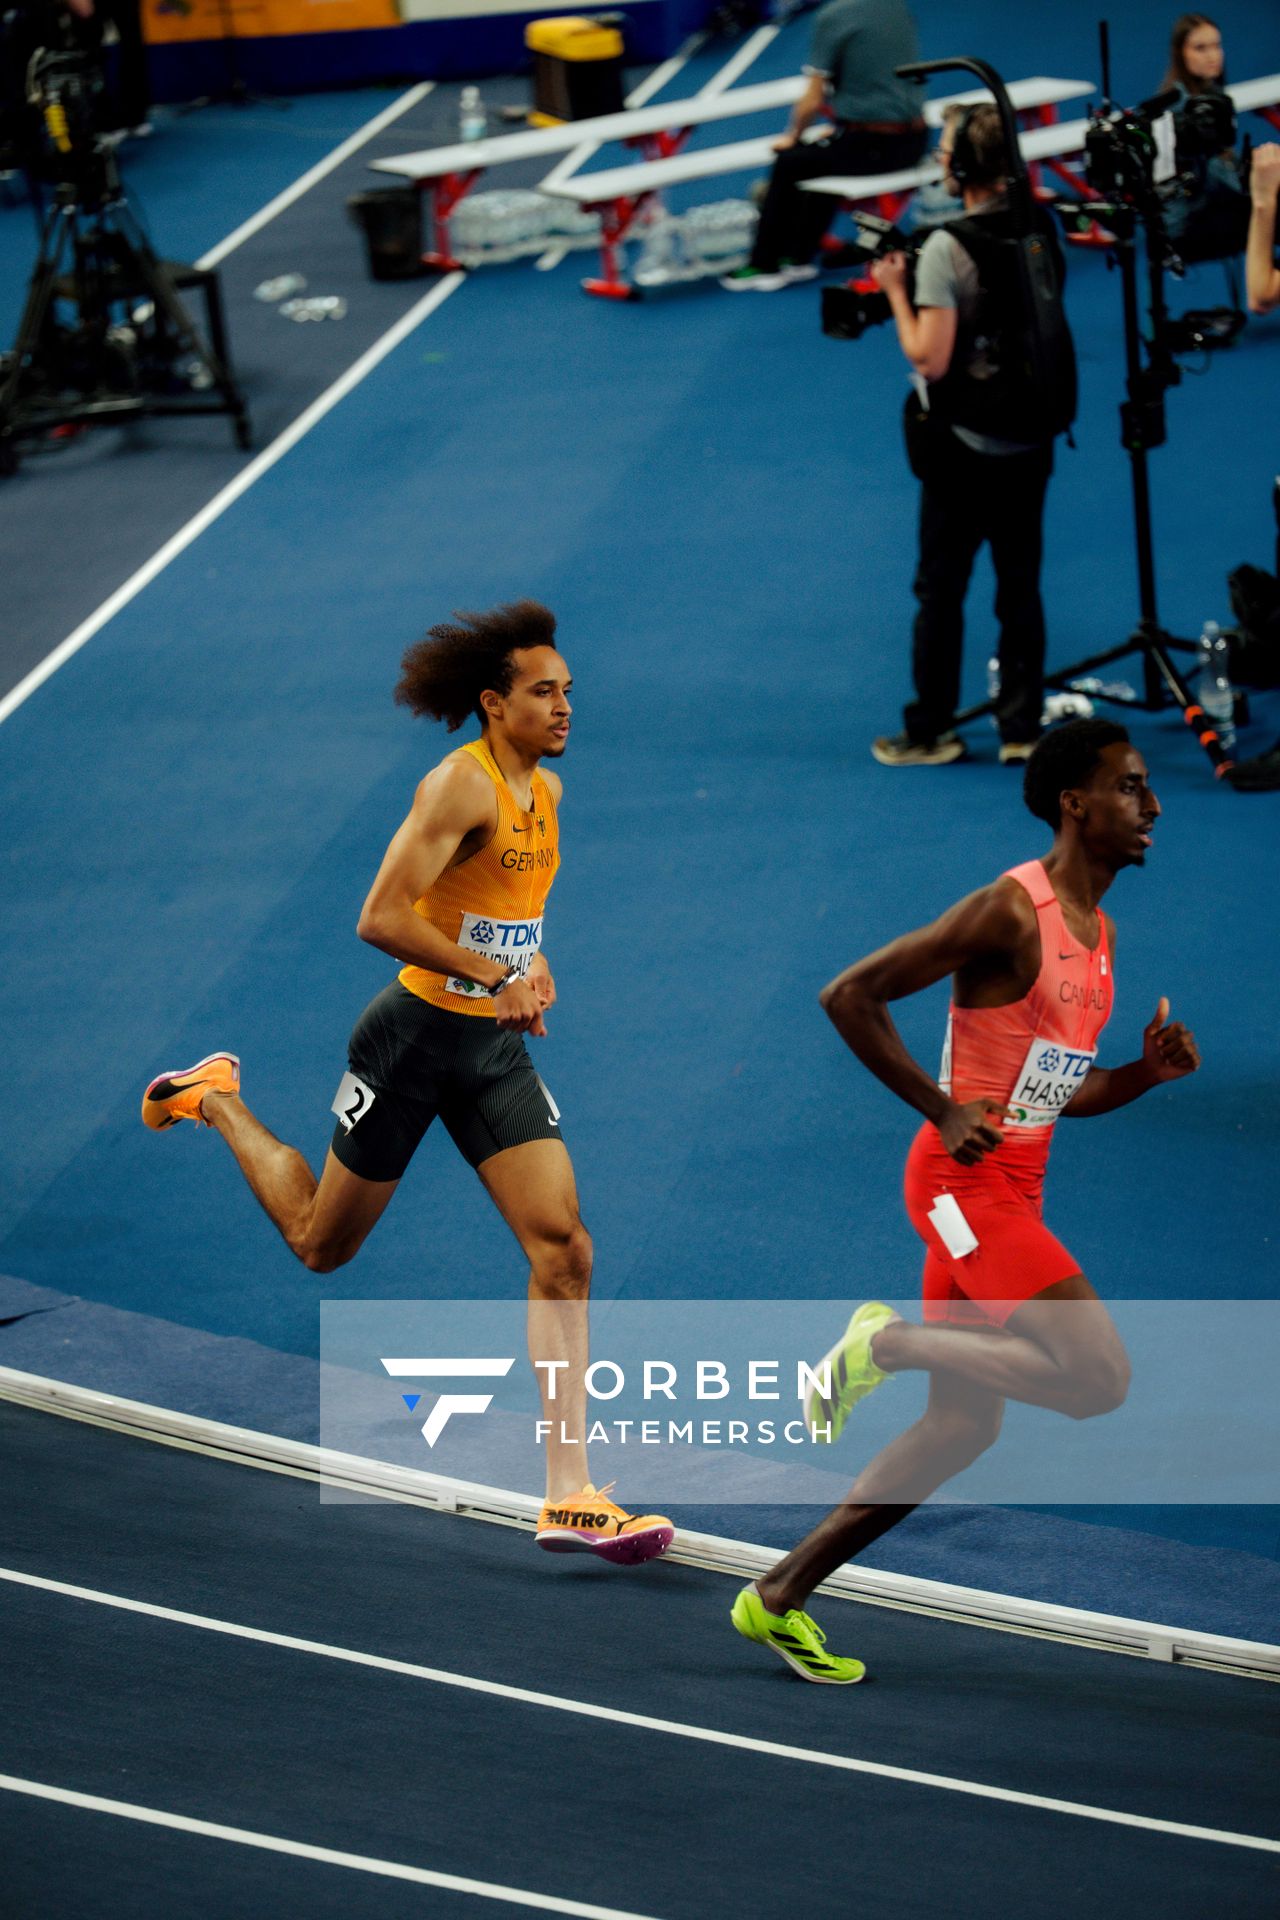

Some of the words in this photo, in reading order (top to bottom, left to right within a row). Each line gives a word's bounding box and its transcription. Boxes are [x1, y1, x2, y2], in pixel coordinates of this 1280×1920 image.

[496, 922, 540, 947] TDK
[1059, 980, 1109, 1010] CANAD
[1061, 1052, 1094, 1077] TD
[344, 1086, 365, 1125] 2
[546, 1509, 609, 1528] NITRO
